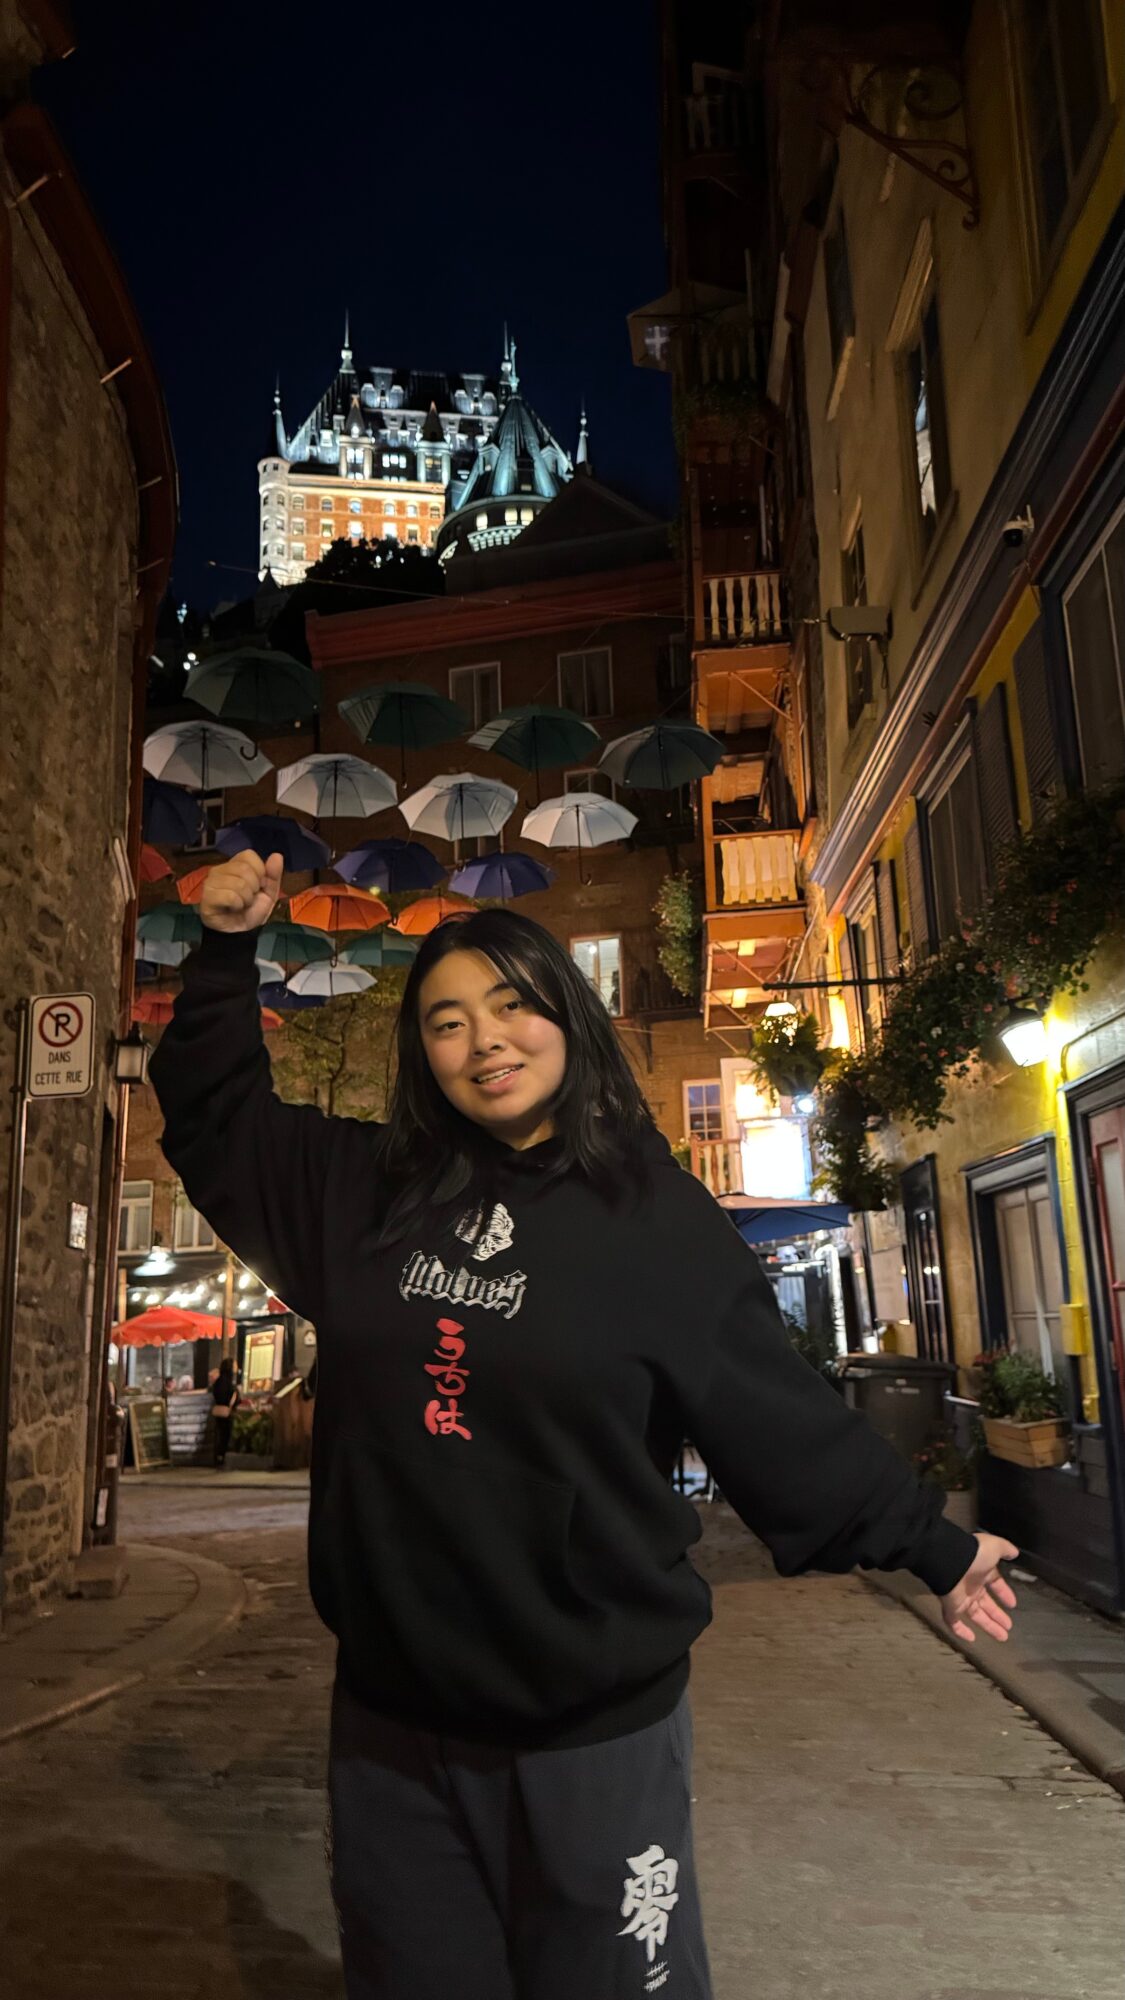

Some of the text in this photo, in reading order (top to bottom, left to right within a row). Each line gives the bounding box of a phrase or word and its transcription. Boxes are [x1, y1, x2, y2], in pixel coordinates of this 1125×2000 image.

[48, 1051, 72, 1064] DANS
[35, 1070, 82, 1085] CETTE RUE
